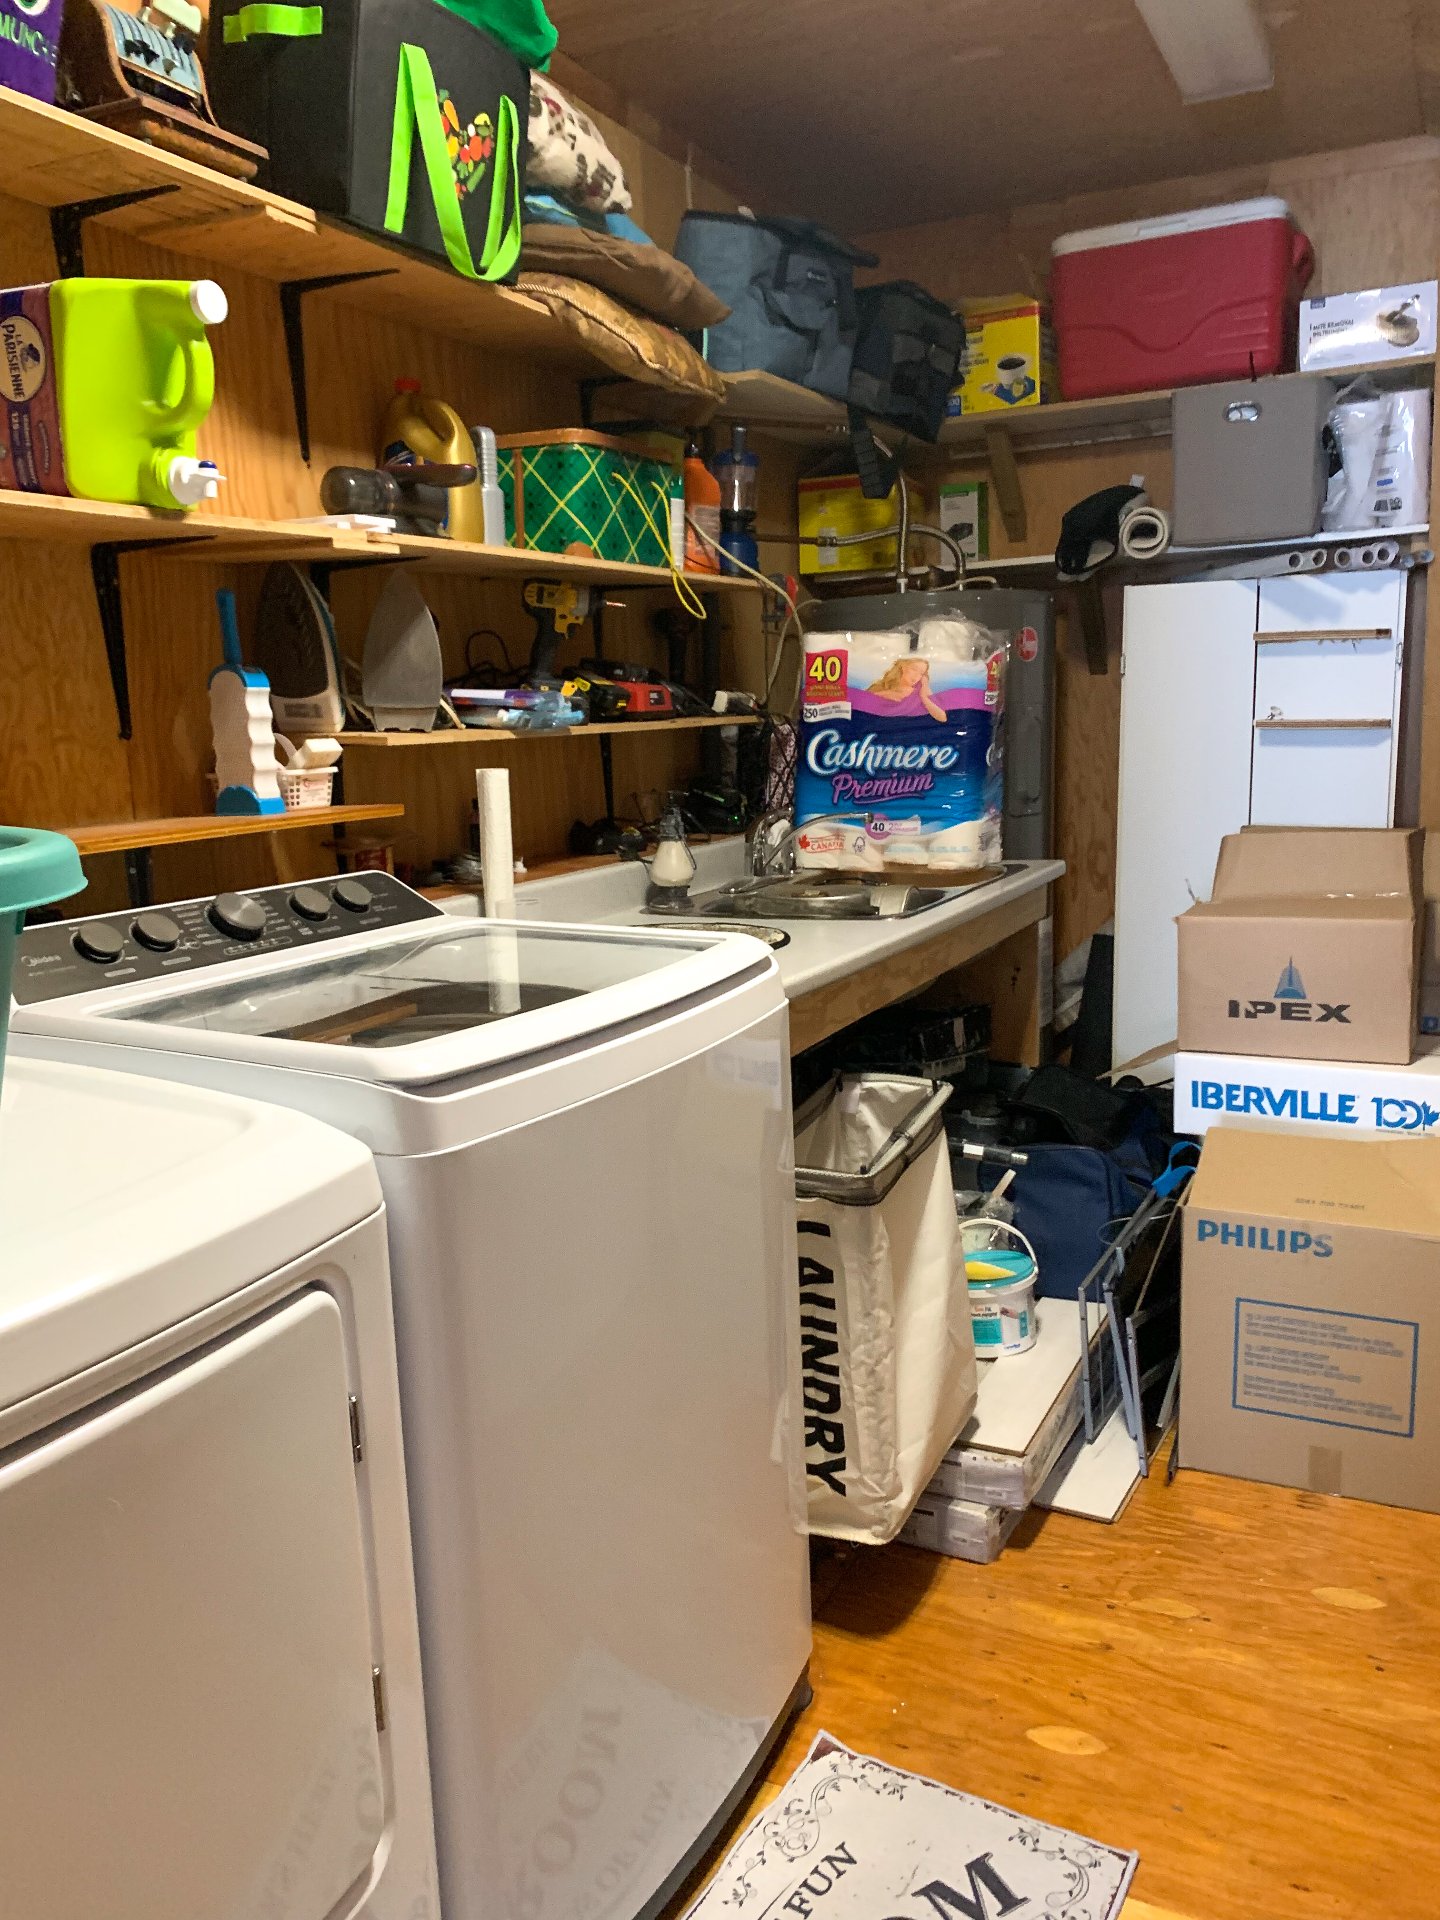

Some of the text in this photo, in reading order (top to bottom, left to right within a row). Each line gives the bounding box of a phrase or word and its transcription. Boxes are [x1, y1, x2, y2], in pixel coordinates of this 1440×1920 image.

[2, 322, 26, 399] PARISIENNE
[808, 655, 842, 683] 40
[803, 708, 818, 719] 250
[806, 729, 959, 776] Cashmere
[831, 772, 934, 805] Premium
[871, 822, 885, 832] 40
[1228, 1000, 1352, 1024] IPEX
[1191, 1080, 1360, 1124] IBERVILLE
[1196, 1219, 1334, 1258] PHILIPS
[782, 1841, 858, 1920] FUN
